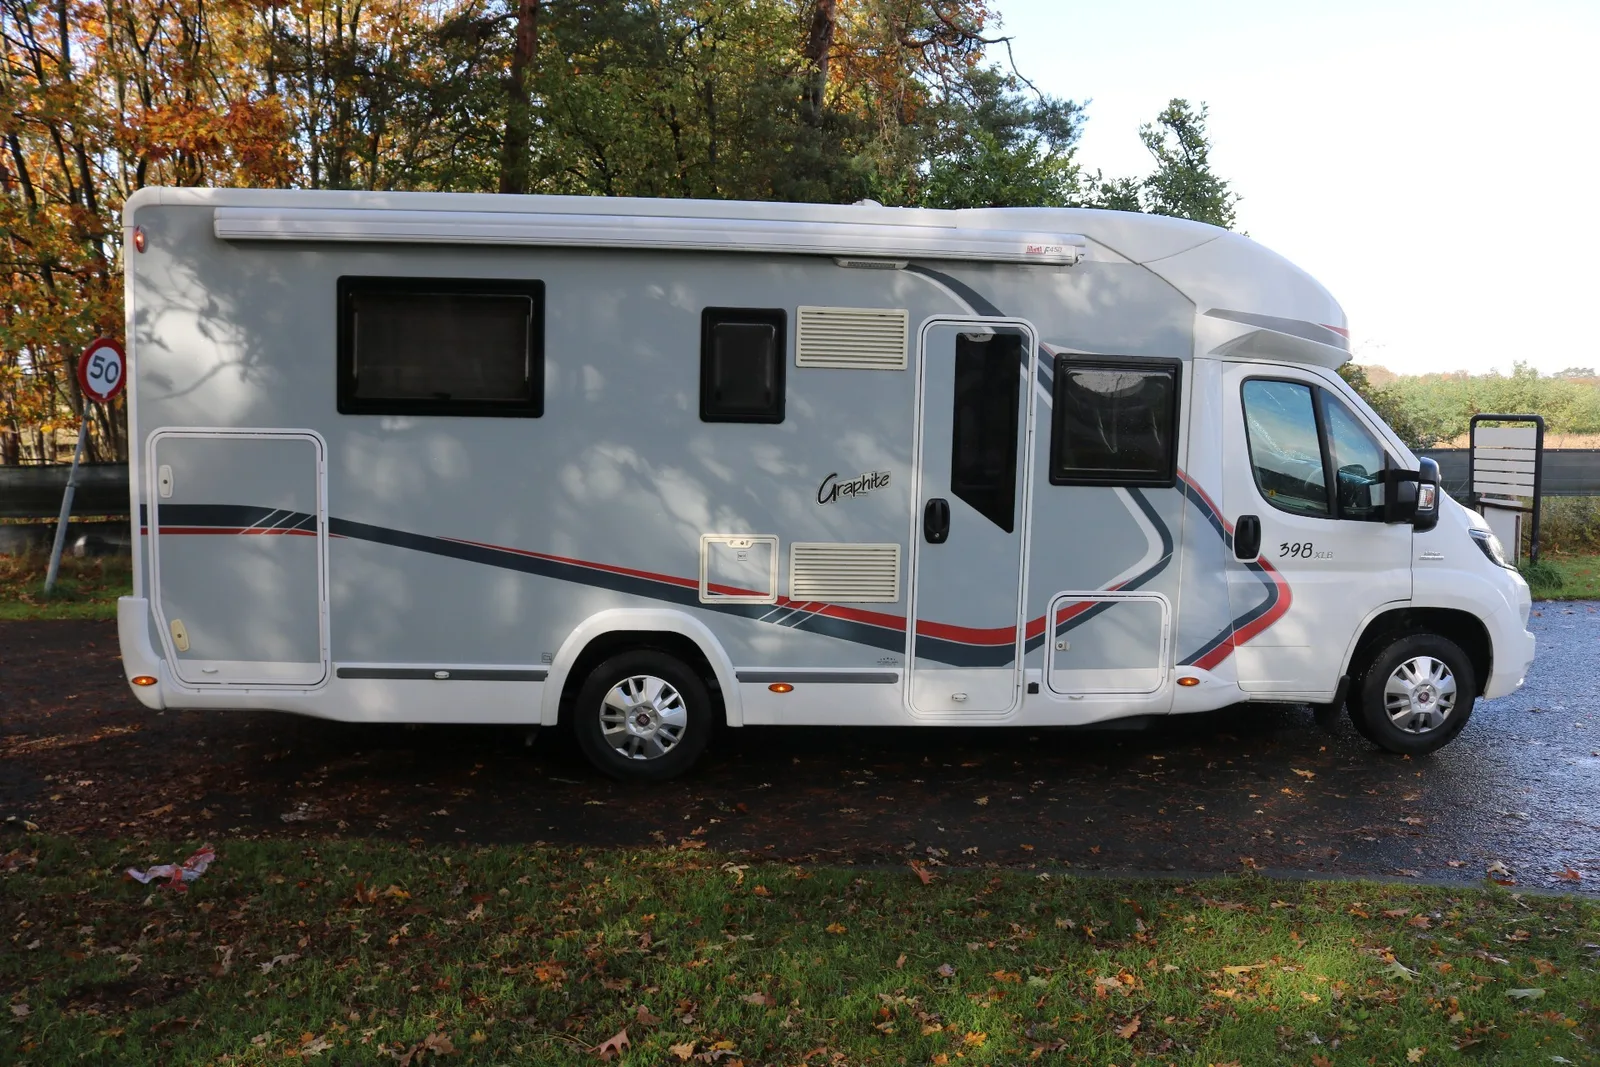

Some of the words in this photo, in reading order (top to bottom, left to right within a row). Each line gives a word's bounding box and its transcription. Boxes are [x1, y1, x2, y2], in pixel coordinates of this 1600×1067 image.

[90, 355, 119, 384] 50
[818, 472, 890, 504] Graphite
[1279, 542, 1313, 559] 398
[1314, 551, 1334, 559] XLB
